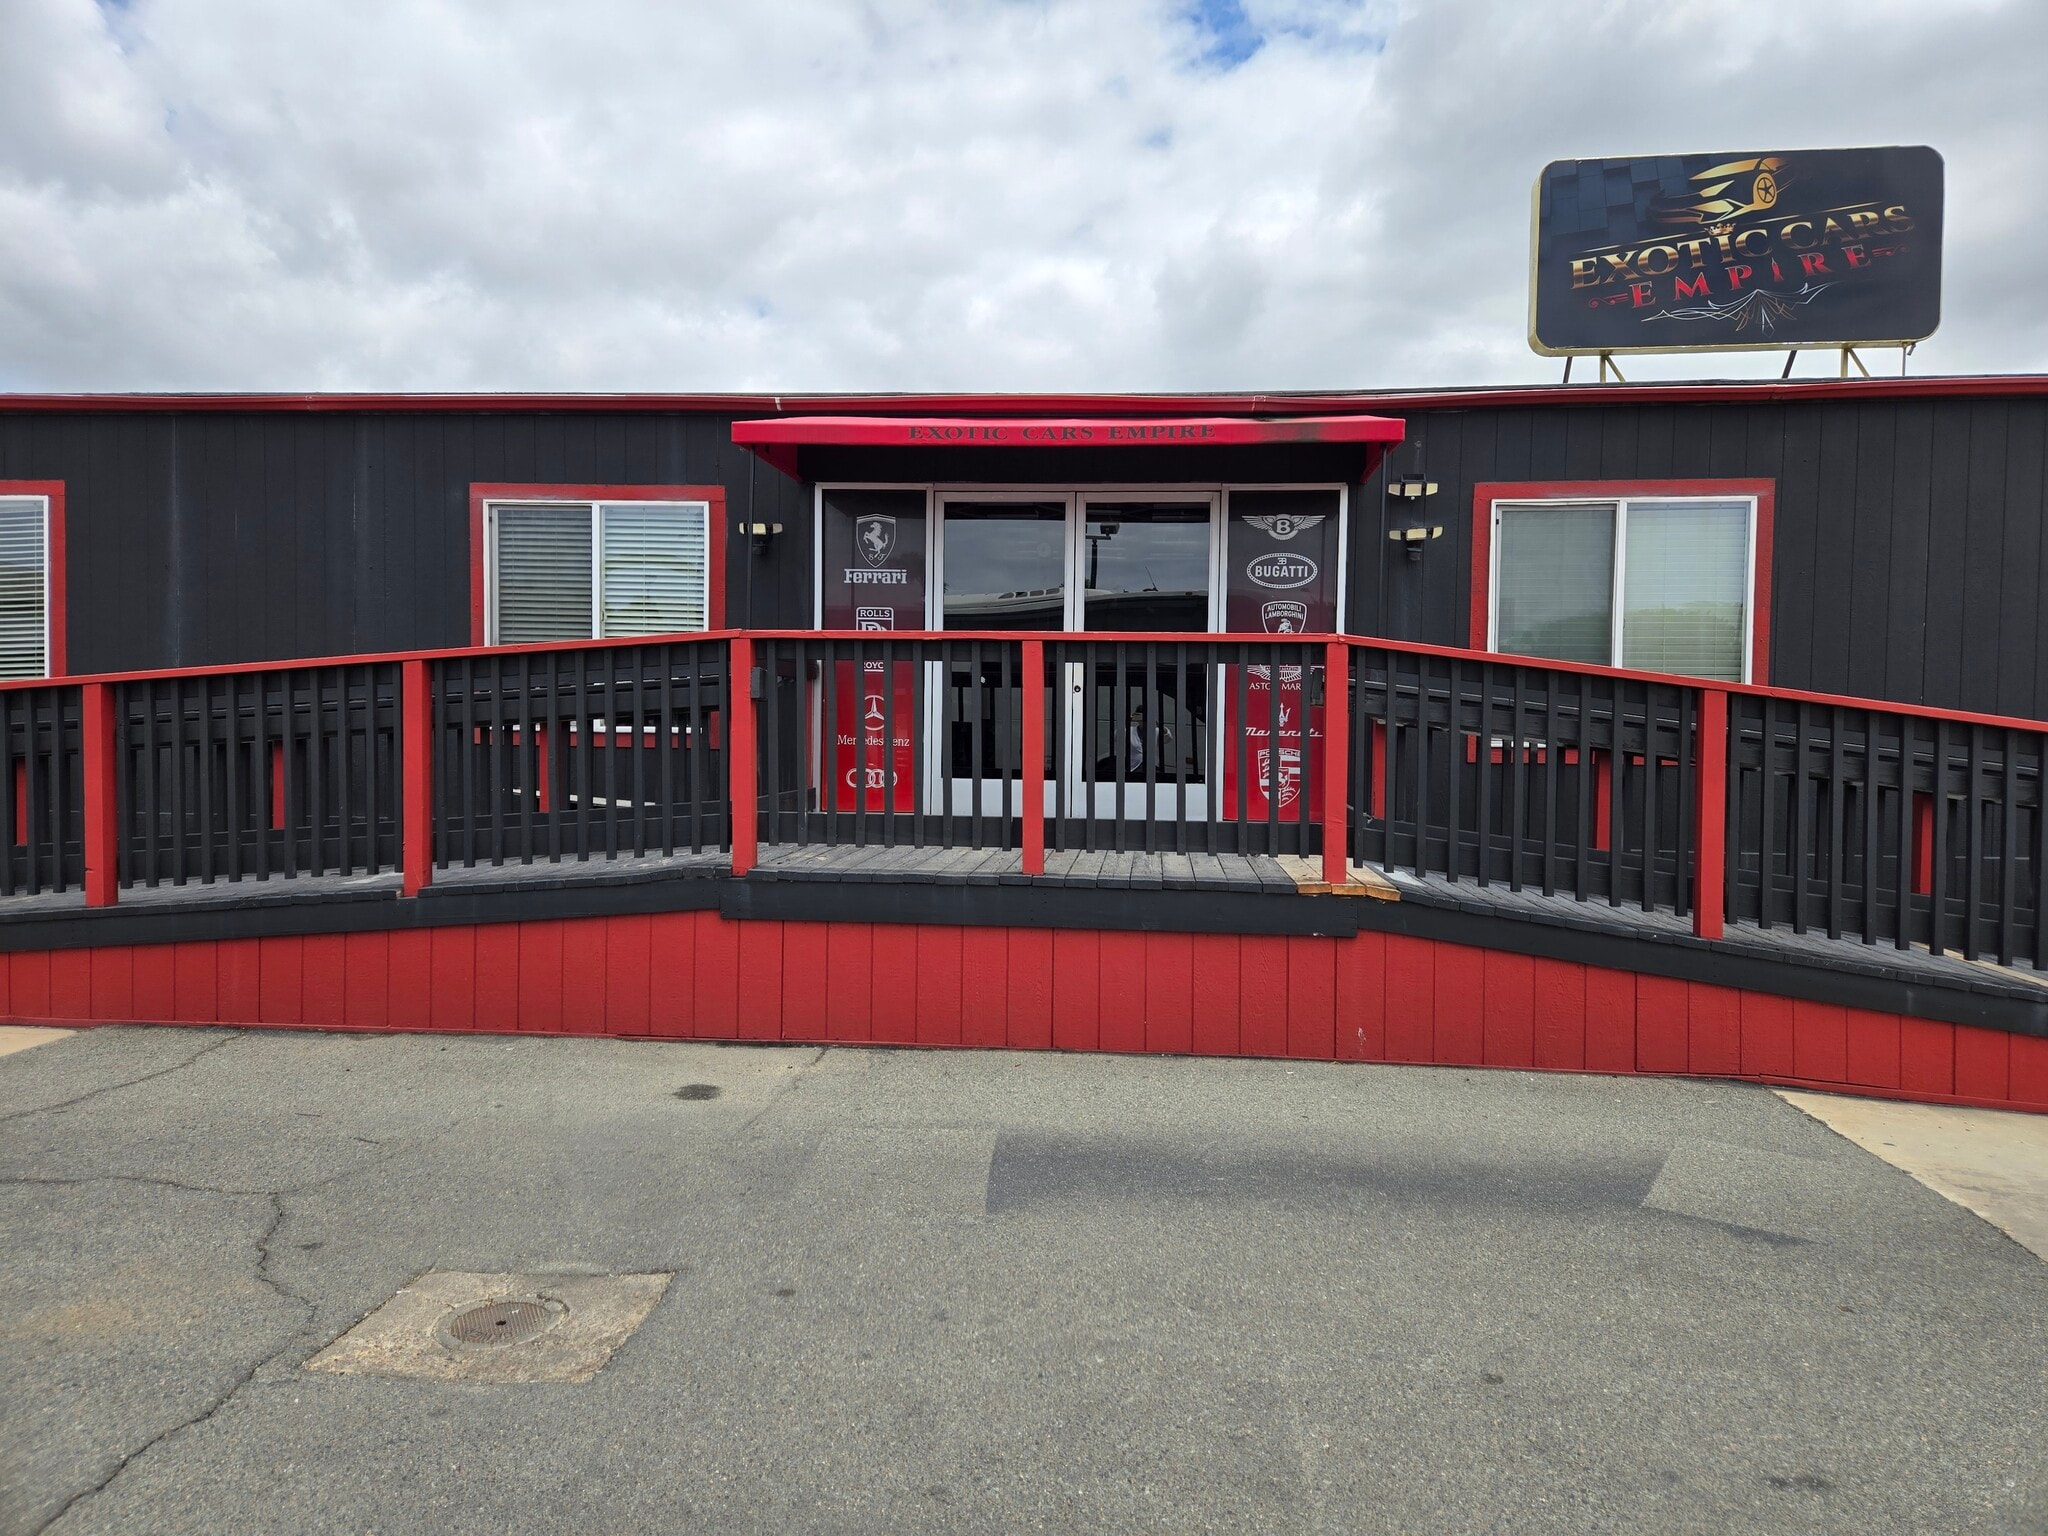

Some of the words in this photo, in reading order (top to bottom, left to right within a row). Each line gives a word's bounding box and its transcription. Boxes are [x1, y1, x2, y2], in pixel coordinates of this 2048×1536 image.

[1569, 228, 1773, 290] EXOTIC
[1780, 205, 1915, 250] CARS
[1632, 244, 1874, 309] EMPIRE
[908, 426, 1008, 440] EXOTIC
[1022, 426, 1093, 440] CARS
[1107, 424, 1216, 440] EMPIRE
[1276, 519, 1291, 534] B
[844, 568, 907, 584] Ferrari
[1255, 565, 1308, 578] BUGATTI
[860, 609, 890, 618] ROLLS
[1267, 603, 1302, 612] AUTOMOBILI
[1265, 610, 1304, 620] LAMBORGHINI
[1249, 682, 1272, 690] ASTO
